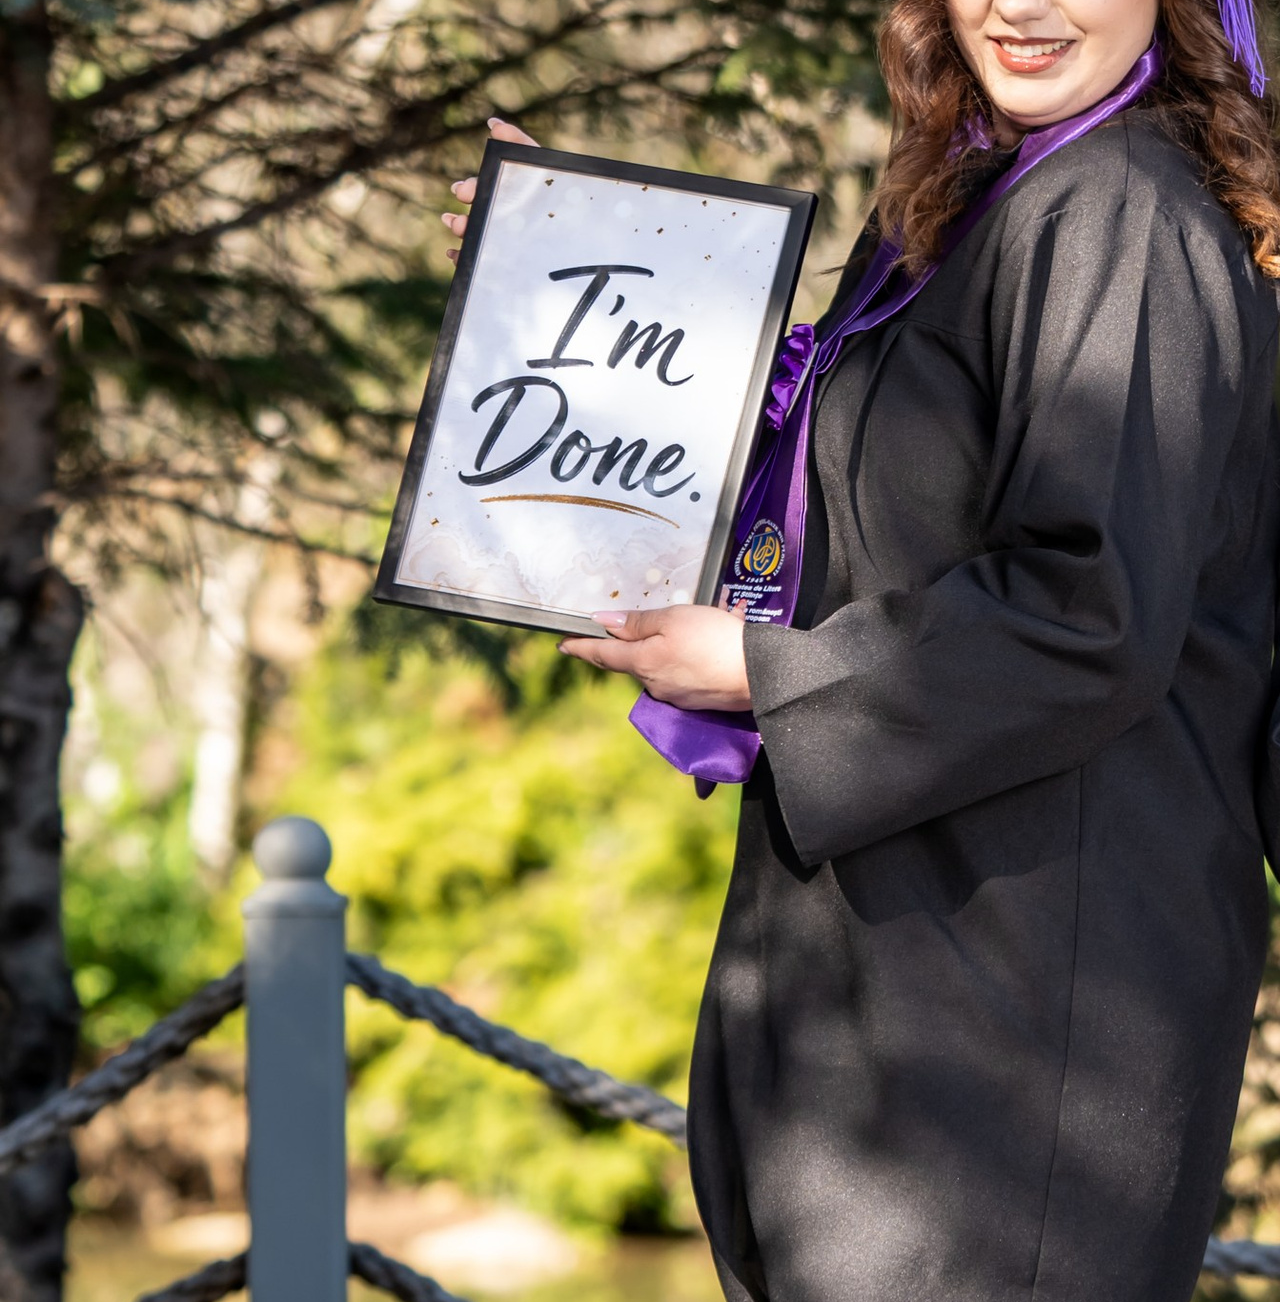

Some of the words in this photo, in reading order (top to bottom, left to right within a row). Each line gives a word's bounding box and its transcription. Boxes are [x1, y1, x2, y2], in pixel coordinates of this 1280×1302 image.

[527, 264, 694, 387] I'm
[458, 375, 702, 503] Done.
[731, 598, 757, 606] Mer
[745, 615, 771, 623] uropean
